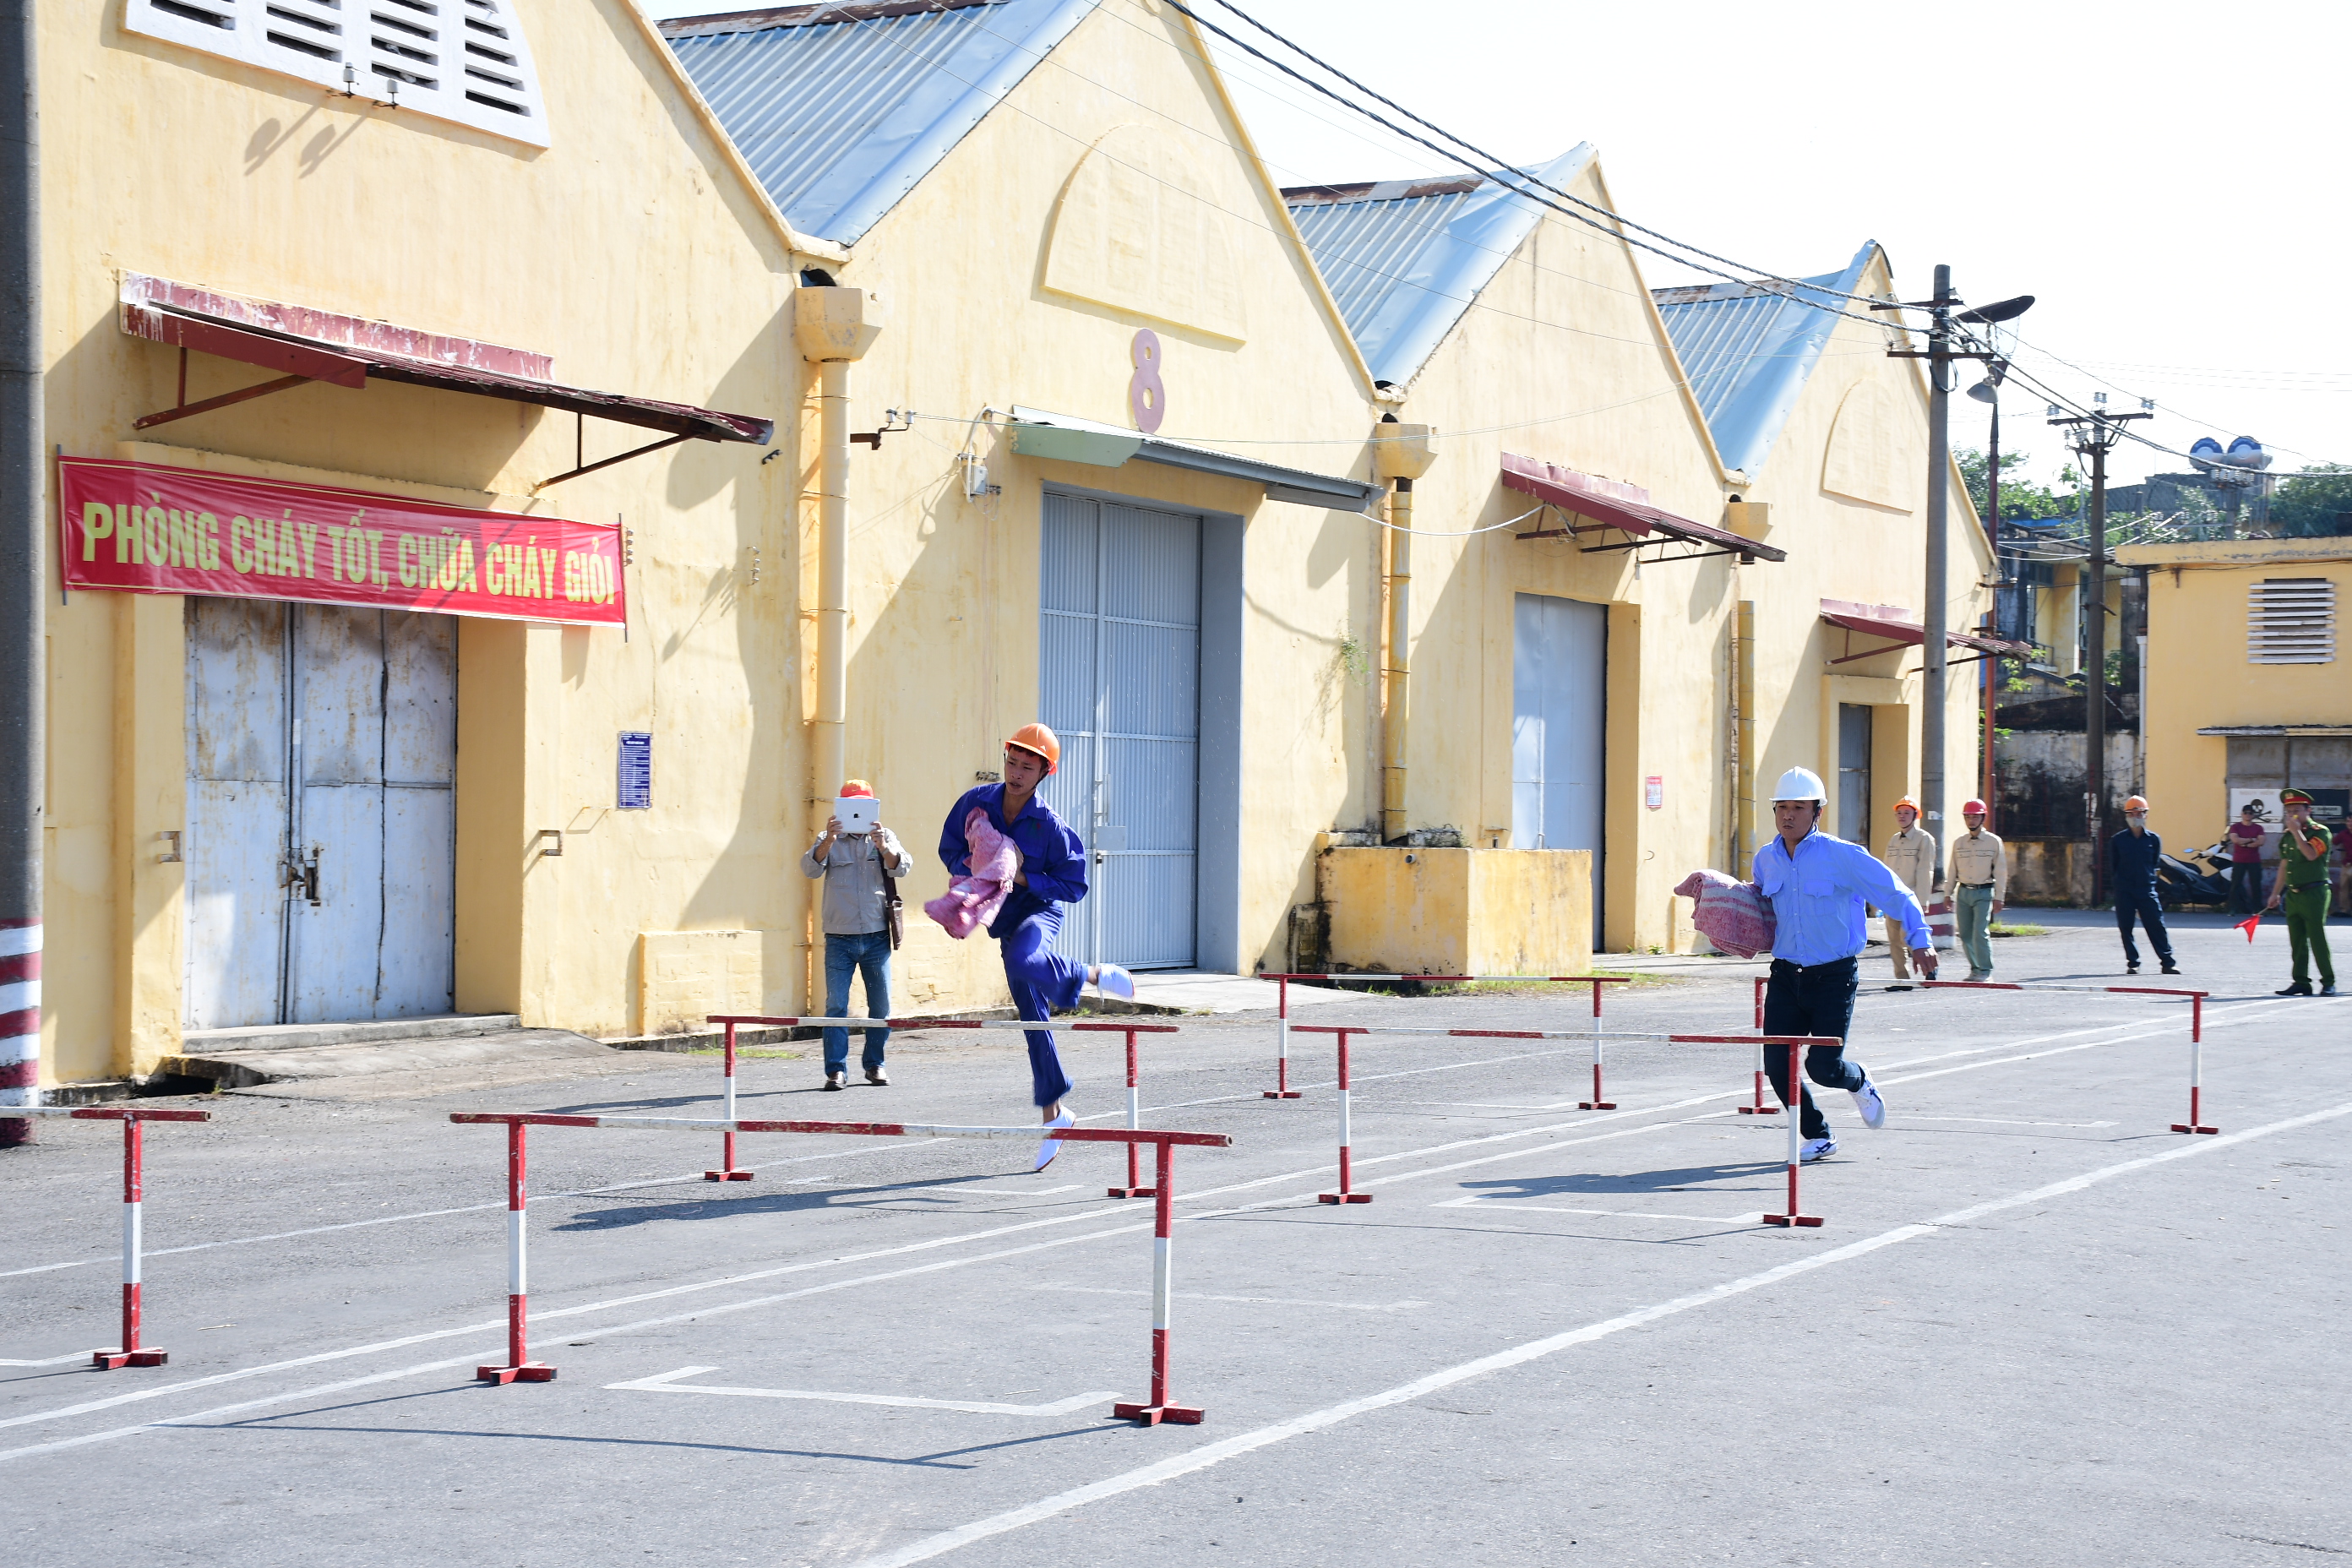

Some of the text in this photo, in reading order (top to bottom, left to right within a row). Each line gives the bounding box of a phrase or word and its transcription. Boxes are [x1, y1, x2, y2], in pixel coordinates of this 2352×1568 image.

[1130, 328, 1165, 433] 8
[82, 492, 615, 605] PHÒNG CHÁY TỐT, CHỮA CHÁY GIỎI
